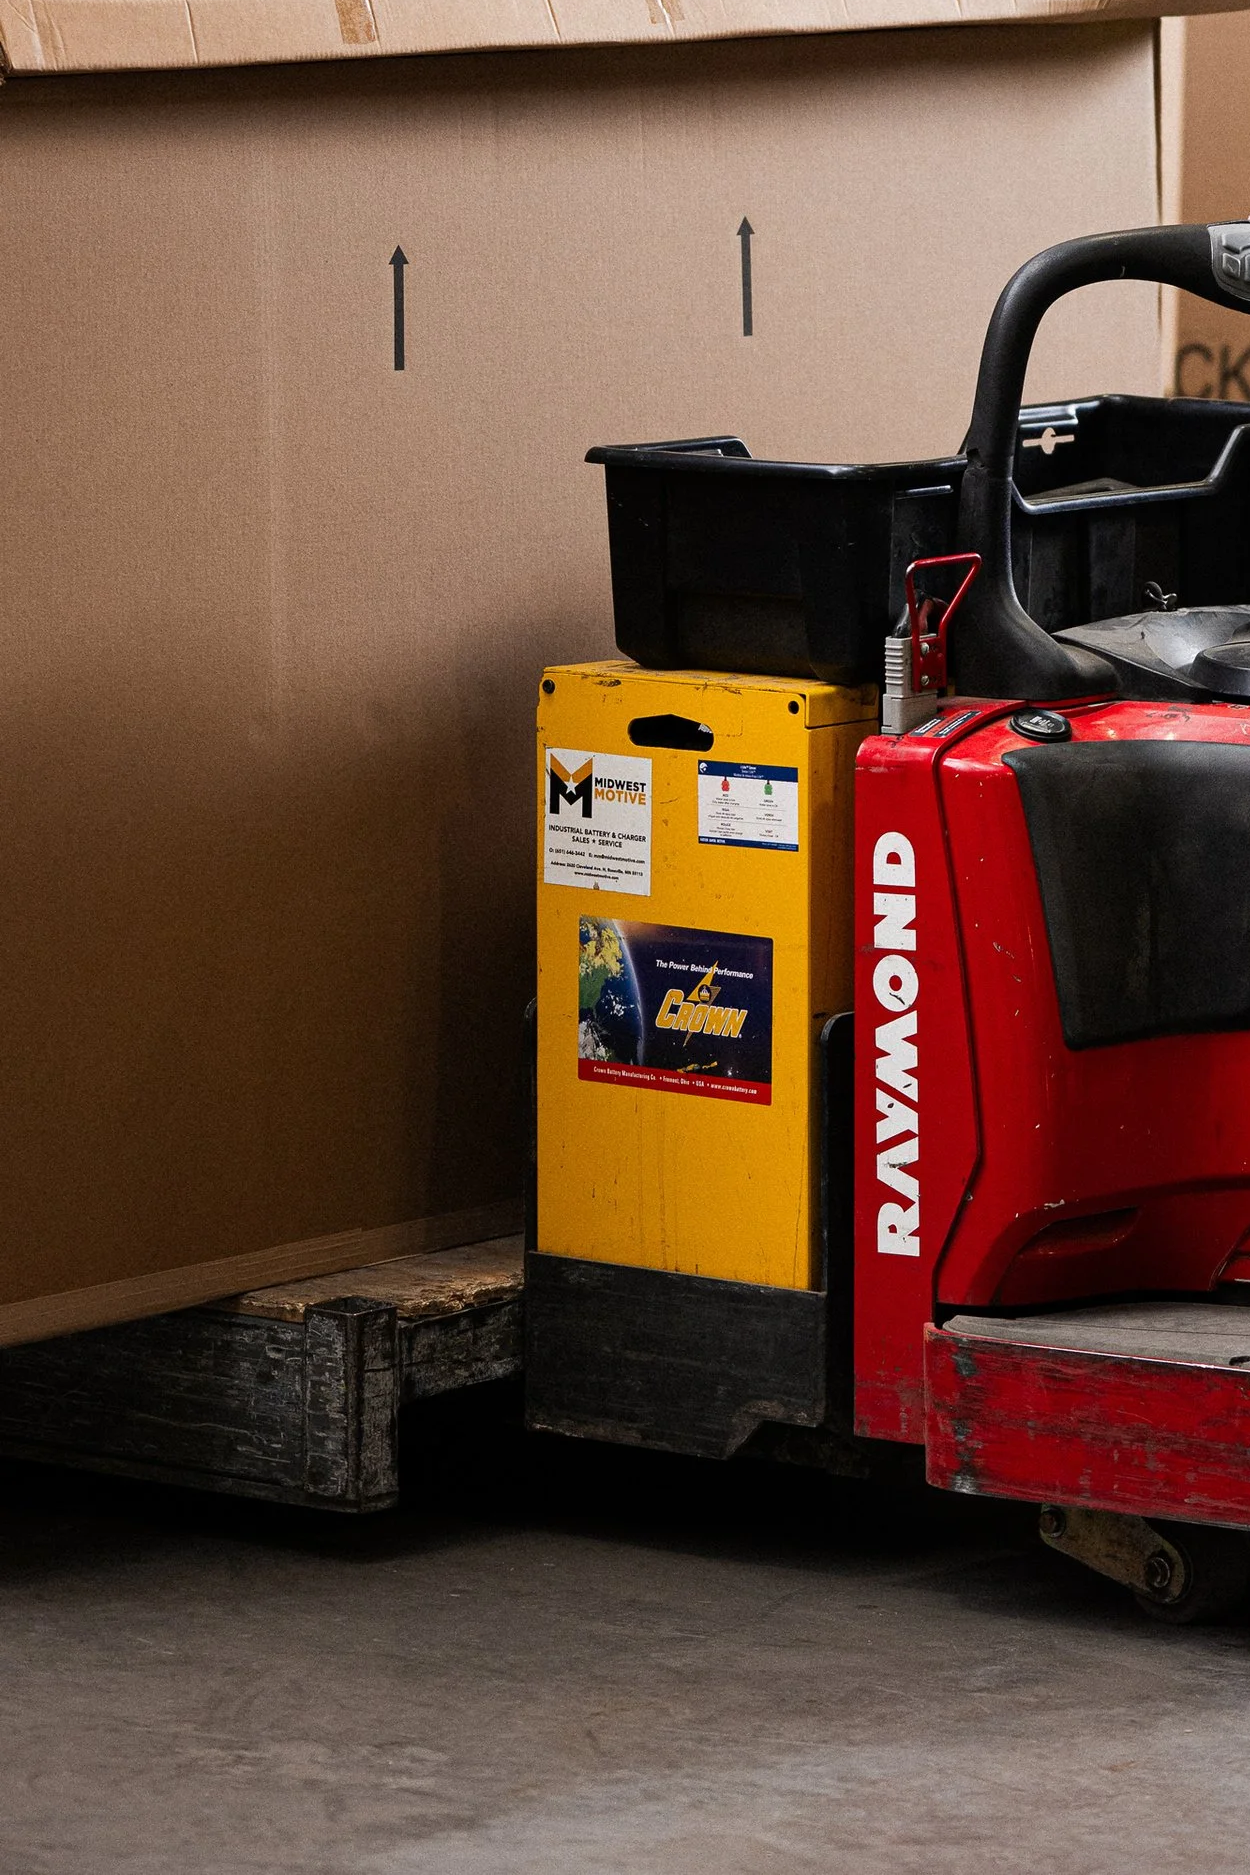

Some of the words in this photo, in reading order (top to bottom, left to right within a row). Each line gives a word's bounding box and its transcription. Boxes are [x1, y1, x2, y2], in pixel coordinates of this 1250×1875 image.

[594, 777, 646, 792] MIDWEST
[594, 788, 646, 805] MOTIVE
[548, 824, 583, 834] INDUSTRIAL
[584, 828, 611, 838] BATTERY
[617, 833, 647, 842] CHARGER
[571, 836, 590, 844] SALES
[598, 839, 623, 848] SERVICE
[656, 959, 668, 969] The
[668, 961, 689, 972] Power
[690, 963, 712, 974] Behind
[713, 966, 754, 980] Performance
[872, 831, 920, 1256] RAYMOND
[593, 1066, 607, 1074] Crown
[606, 1067, 621, 1077] Battery
[621, 1069, 650, 1081] Manufacturing
